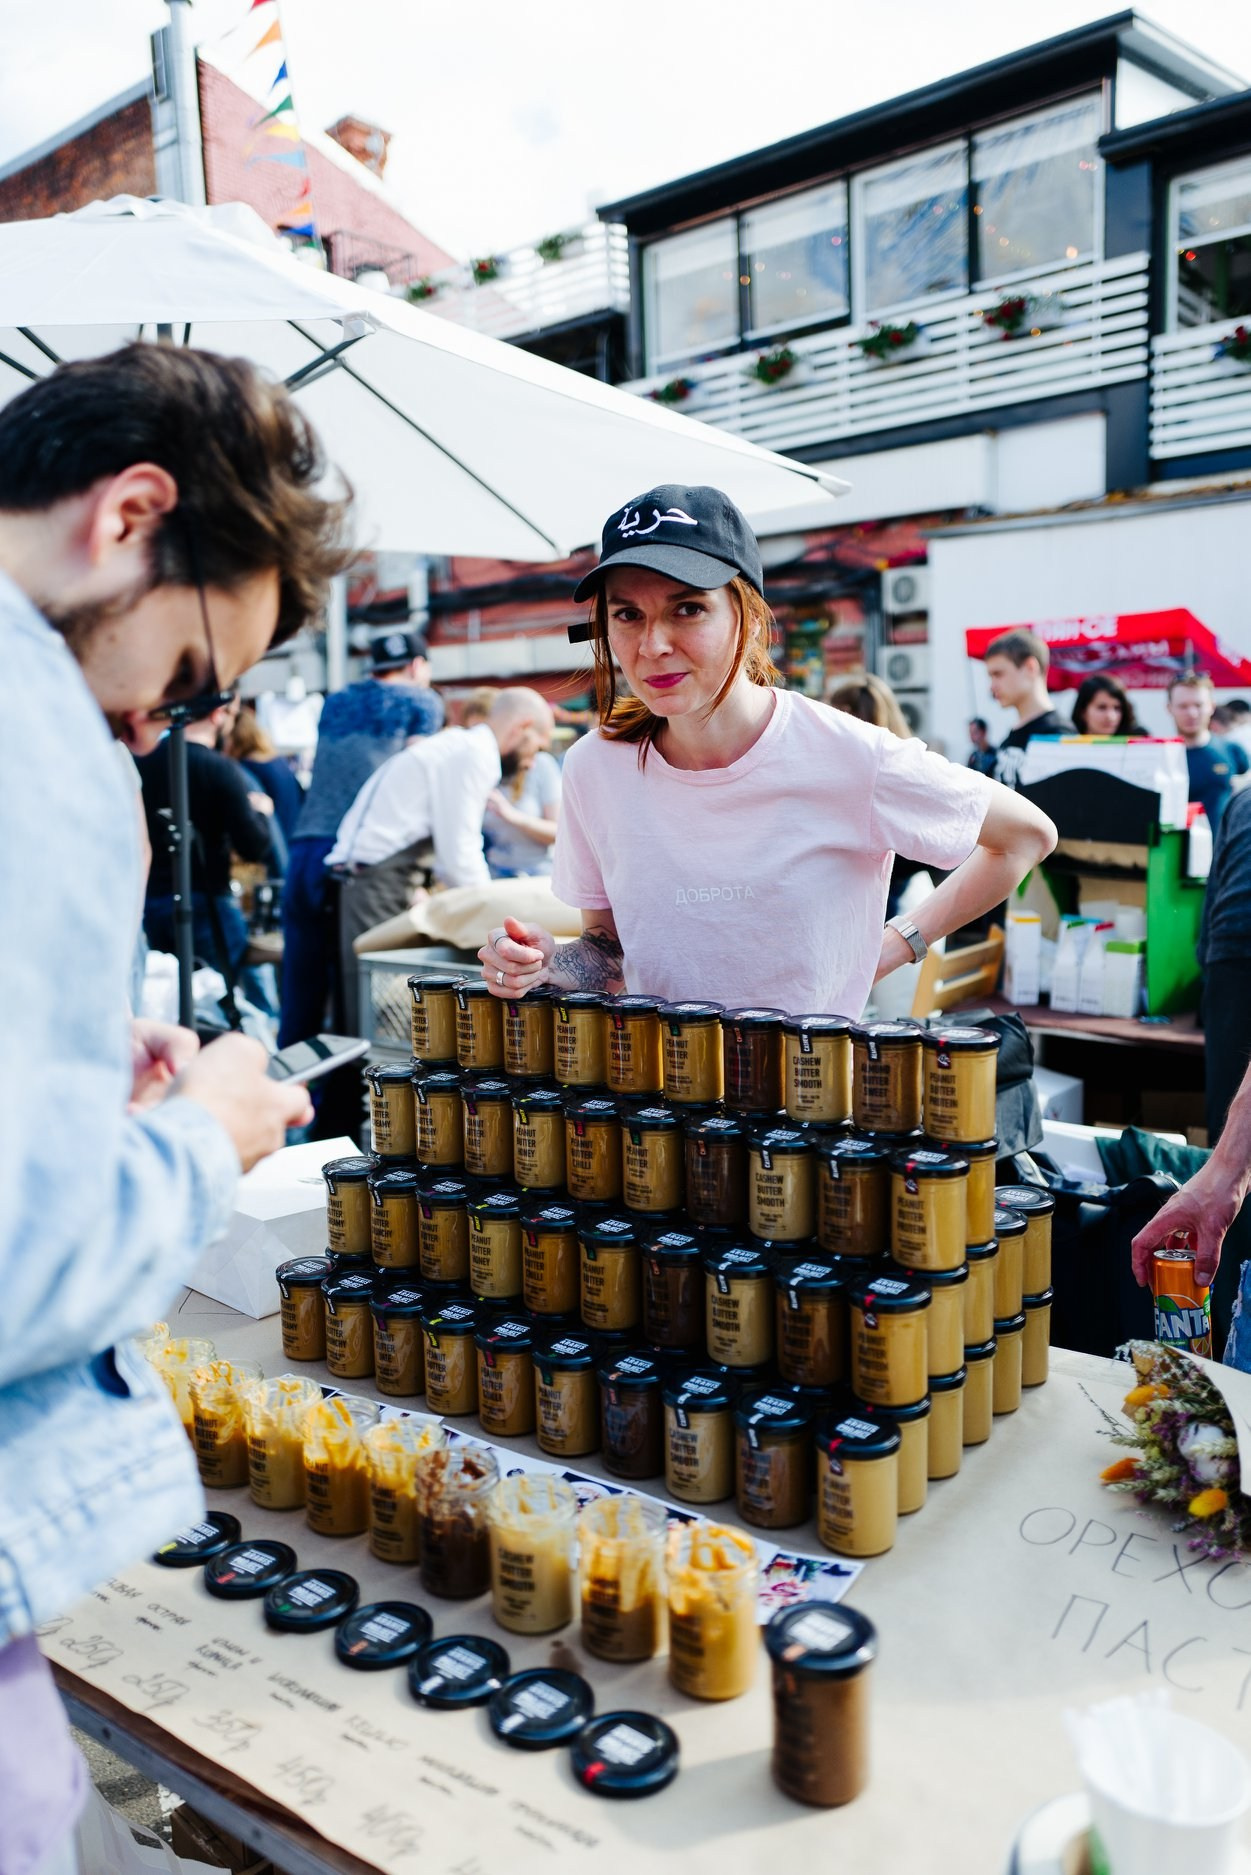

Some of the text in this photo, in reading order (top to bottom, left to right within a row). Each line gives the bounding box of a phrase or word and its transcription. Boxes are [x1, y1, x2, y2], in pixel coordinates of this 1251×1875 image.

[617, 506, 698, 538] حرية
[675, 885, 755, 906] ДОБРОТА
[506, 1018, 525, 1028] PEANUT
[506, 1028, 525, 1038] BUTTER
[557, 1025, 576, 1035] PEANUT
[557, 1035, 576, 1045] BUTTER
[610, 1032, 632, 1041] PEANUT
[610, 1042, 631, 1052] BUTTER
[666, 1038, 688, 1048] PEANUT
[558, 1045, 575, 1055] HONEY
[666, 1049, 688, 1059] BUTTER
[612, 1052, 630, 1062] CHILLI
[793, 1056, 821, 1066] CASHEW
[795, 1068, 820, 1077] BUTTER
[930, 1072, 956, 1084] PEANUT
[794, 1079, 822, 1088] SMOOTH
[930, 1084, 956, 1096] BUTTER
[930, 1096, 957, 1108] PROTEIN
[516, 1128, 536, 1137] PEANUT
[517, 1138, 536, 1148] BUTTER
[571, 1138, 593, 1148] PEANUT
[518, 1148, 535, 1158] HONEY
[572, 1149, 592, 1159] BUTTER
[626, 1146, 648, 1157] PEANUT
[572, 1160, 592, 1169] CHILLI
[627, 1158, 648, 1168] BUTTER
[756, 1173, 784, 1184] CASHEW
[758, 1185, 782, 1196] BUTTER
[757, 1196, 785, 1207] SMOOTH
[898, 1196, 924, 1209] PEANUT
[898, 1208, 924, 1222] BUTTER
[472, 1234, 491, 1246] PEANUT
[472, 1246, 491, 1256] BUTTER
[525, 1248, 544, 1260] PEANUT
[472, 1256, 490, 1266] HONEY
[526, 1260, 544, 1271] BUTTER
[583, 1262, 604, 1274] PEANUT
[526, 1270, 543, 1280] CHILLI
[584, 1274, 604, 1286] BUTTER
[711, 1295, 739, 1308] CASHEW
[448, 1305, 474, 1315] ARAHIS
[713, 1307, 738, 1320] BUTTER
[502, 1322, 530, 1332] ARAHIS
[712, 1318, 740, 1332] SMOOTH
[1154, 1308, 1210, 1338] FANTA
[560, 1339, 589, 1350] ARAHIS
[427, 1350, 446, 1362] PEANUT
[427, 1360, 446, 1372] BUTTER
[624, 1356, 654, 1368] ARAHIS
[428, 1372, 446, 1382] HONEY
[482, 1367, 503, 1379] PEANUT
[482, 1378, 503, 1391] BUTTER
[538, 1386, 561, 1398] PEANUT
[671, 1440, 696, 1455] BUTTER
